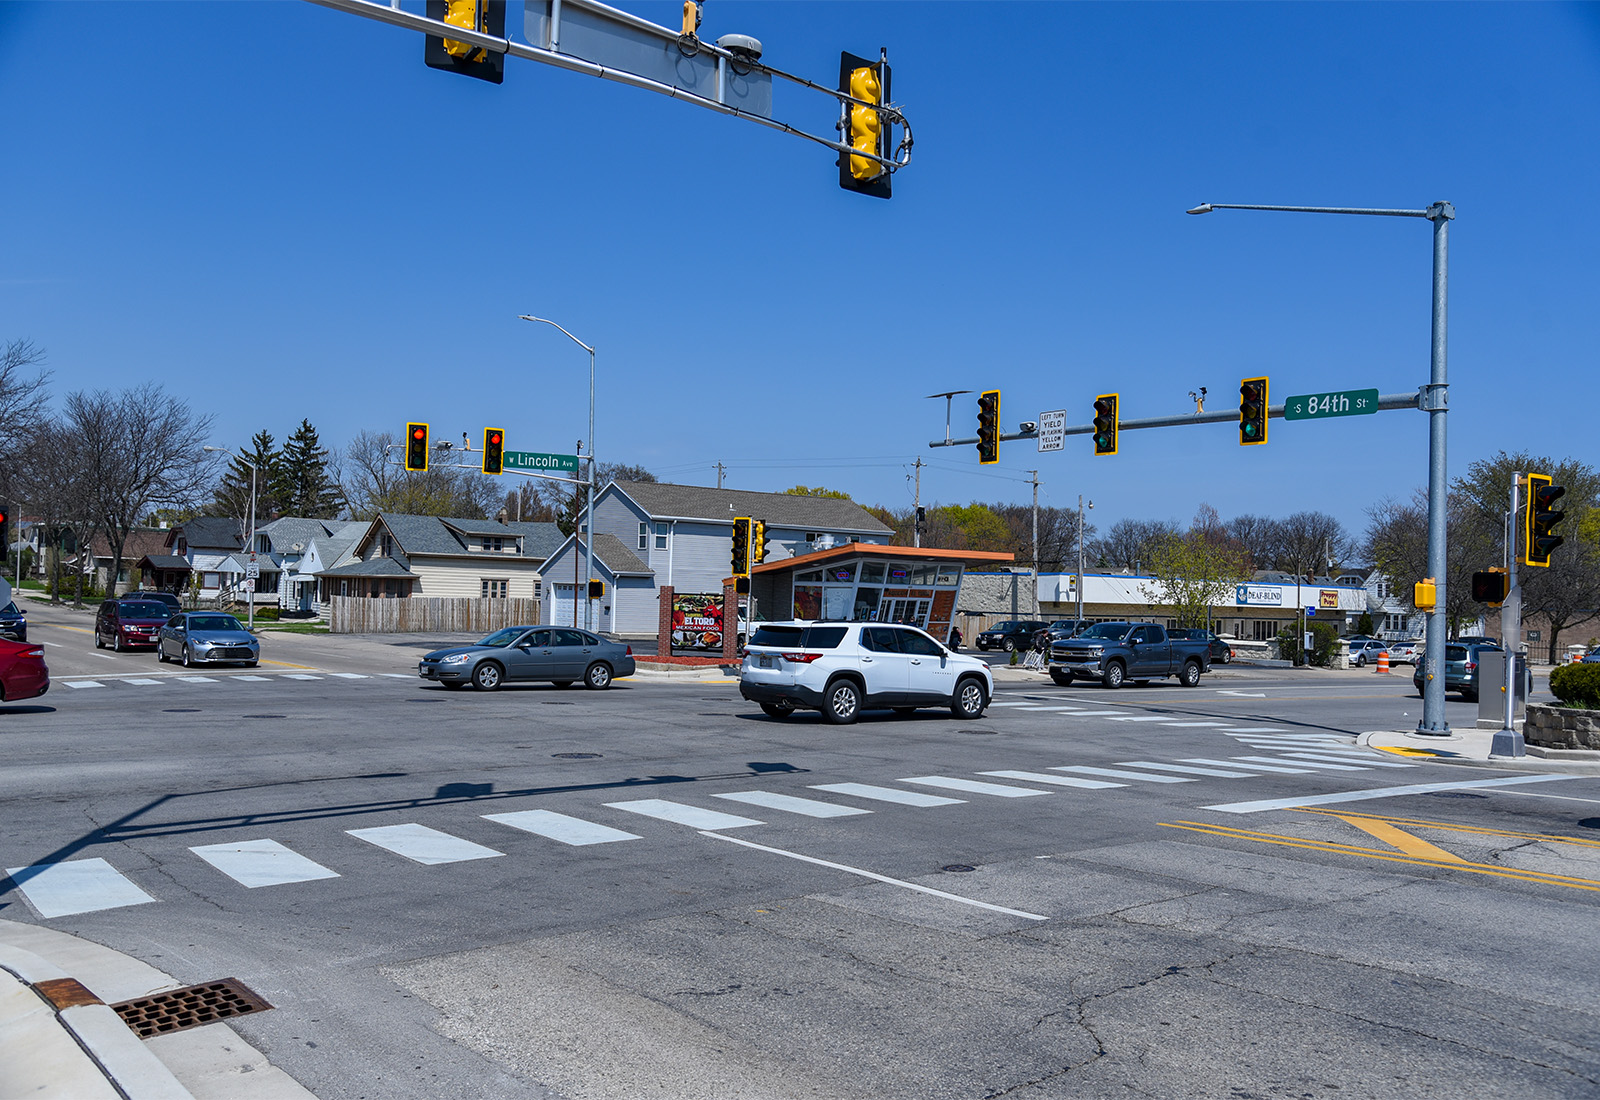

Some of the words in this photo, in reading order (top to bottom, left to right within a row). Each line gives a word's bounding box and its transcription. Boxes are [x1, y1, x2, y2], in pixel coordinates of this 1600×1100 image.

[1295, 404, 1302, 413] S
[1308, 394, 1350, 415] 84th
[1356, 398, 1366, 409] St
[1043, 420, 1062, 429] YIELD
[518, 453, 559, 468] Lincoln
[1247, 590, 1281, 600] DEAF-BLIND
[684, 617, 694, 625] EL
[694, 617, 715, 625] TORO
